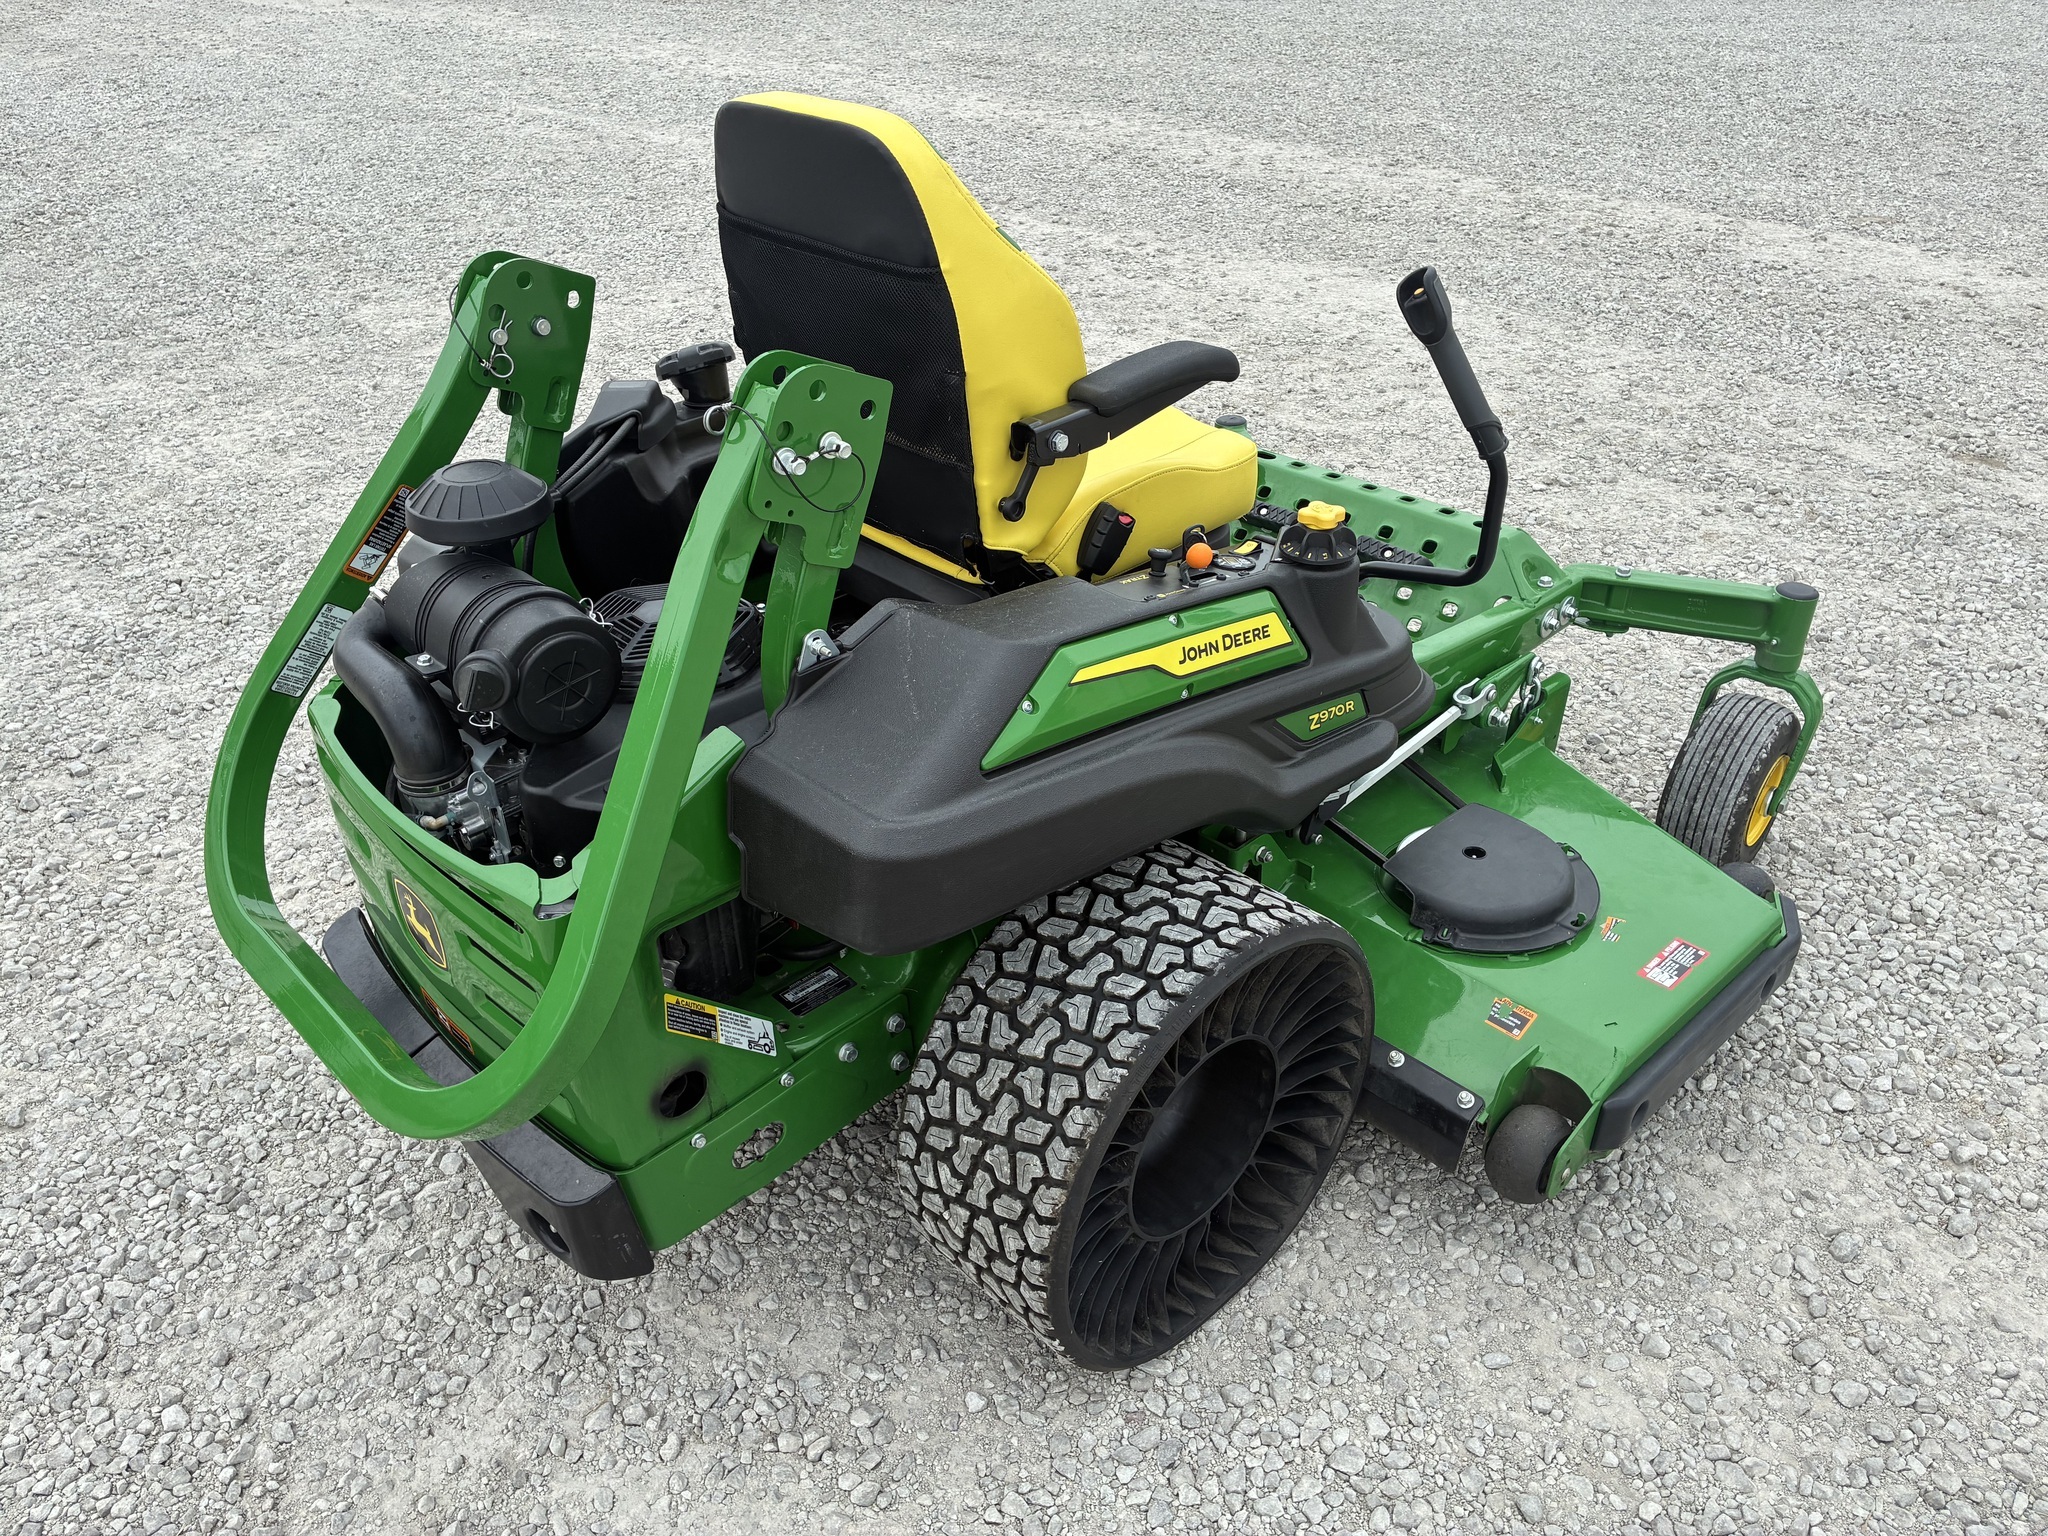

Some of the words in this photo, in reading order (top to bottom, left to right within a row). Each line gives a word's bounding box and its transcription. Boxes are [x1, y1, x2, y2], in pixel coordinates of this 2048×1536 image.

[1178, 639, 1220, 665] JOHN
[1221, 624, 1271, 652] DEERE
[1308, 700, 1355, 731] Z970R
[680, 1000, 706, 1012] CAUTION
